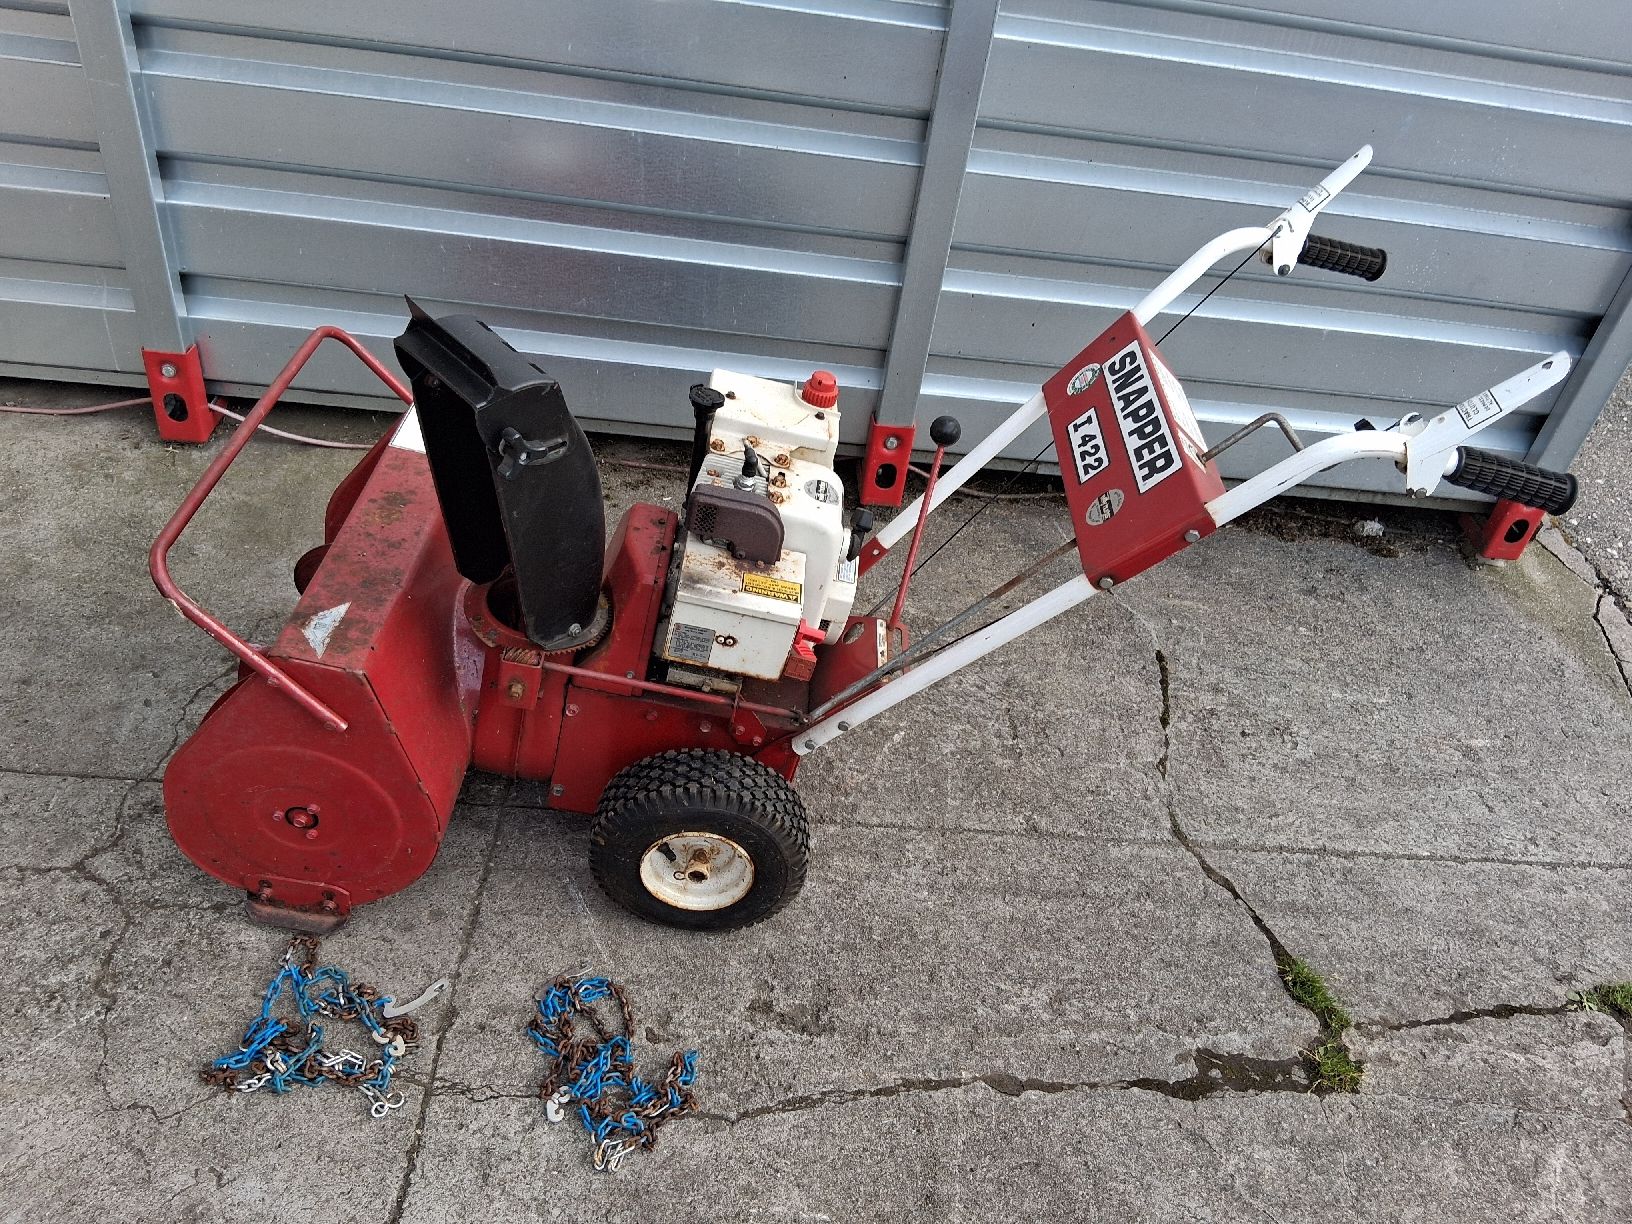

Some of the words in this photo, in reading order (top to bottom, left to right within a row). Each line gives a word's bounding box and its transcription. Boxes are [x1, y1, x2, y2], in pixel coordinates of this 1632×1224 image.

[1107, 350, 1175, 482] SNAPPER
[1075, 433, 1104, 477] 422
[746, 586, 790, 600] WARNING
